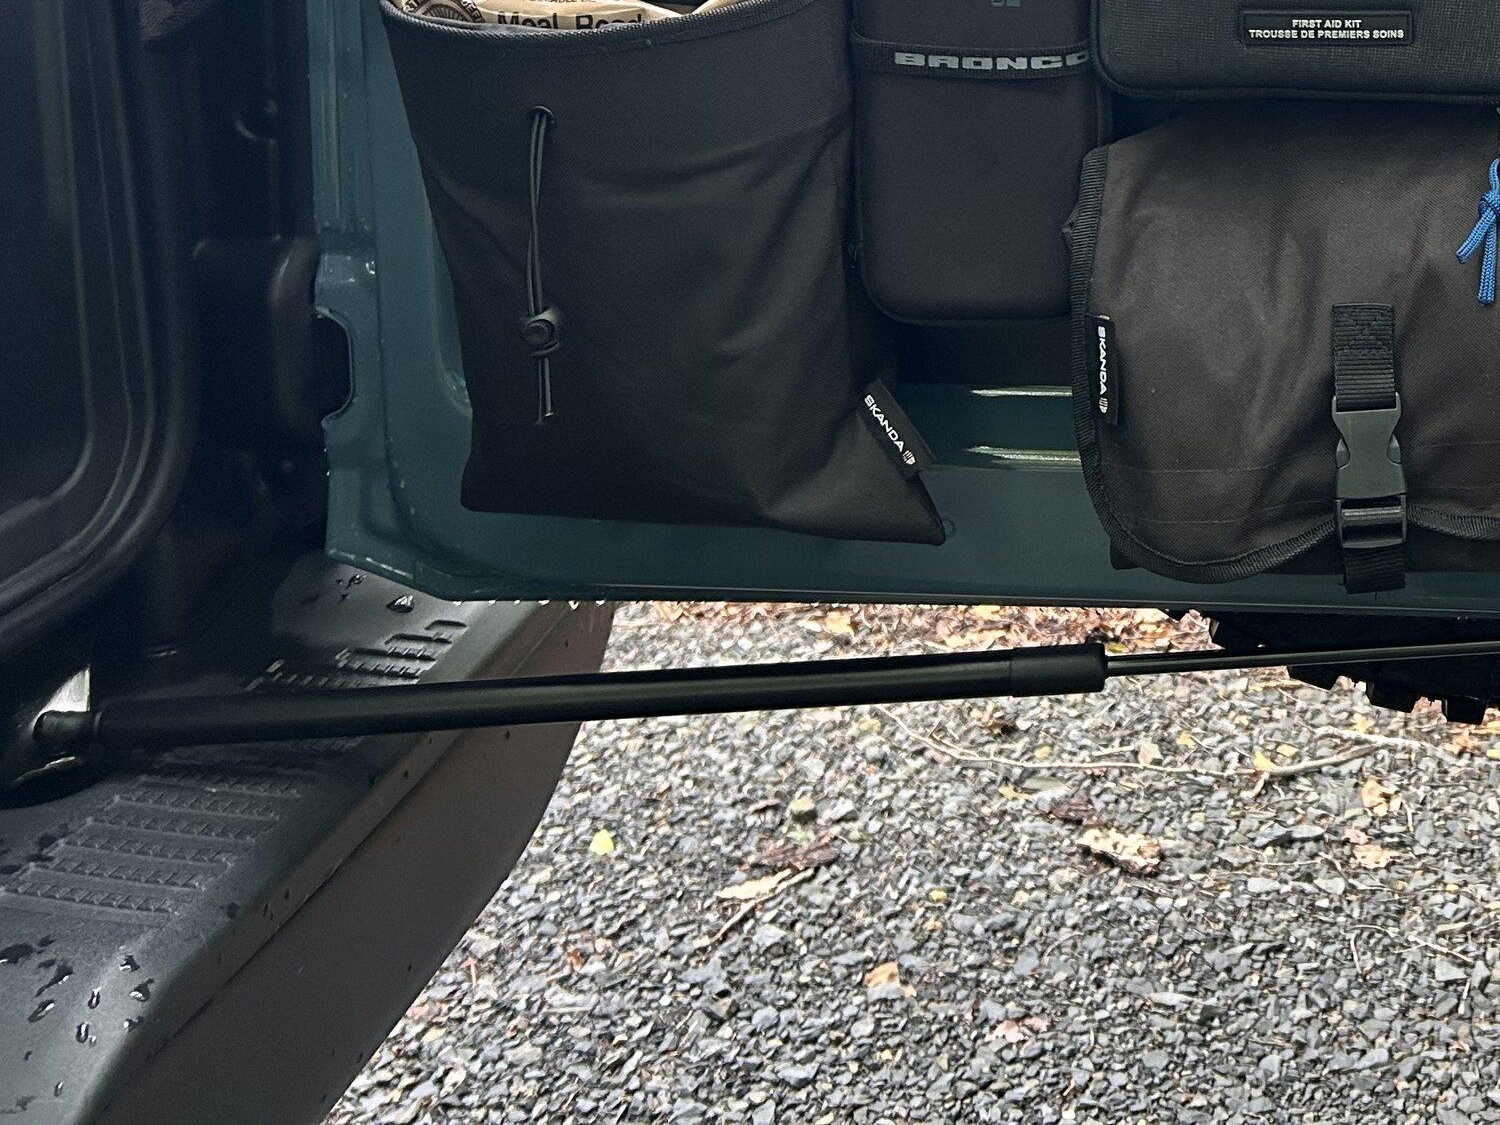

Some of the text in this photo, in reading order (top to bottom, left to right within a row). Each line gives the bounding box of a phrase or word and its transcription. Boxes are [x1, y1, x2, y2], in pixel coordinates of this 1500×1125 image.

[1292, 19, 1362, 29] FIRST AID KIT
[1248, 29, 1404, 39] TROUSSE DE PREMIERS SOINS
[894, 51, 1089, 70] BRONCO
[1097, 326, 1107, 396] SKANDA
[864, 394, 905, 452] SKANDA
